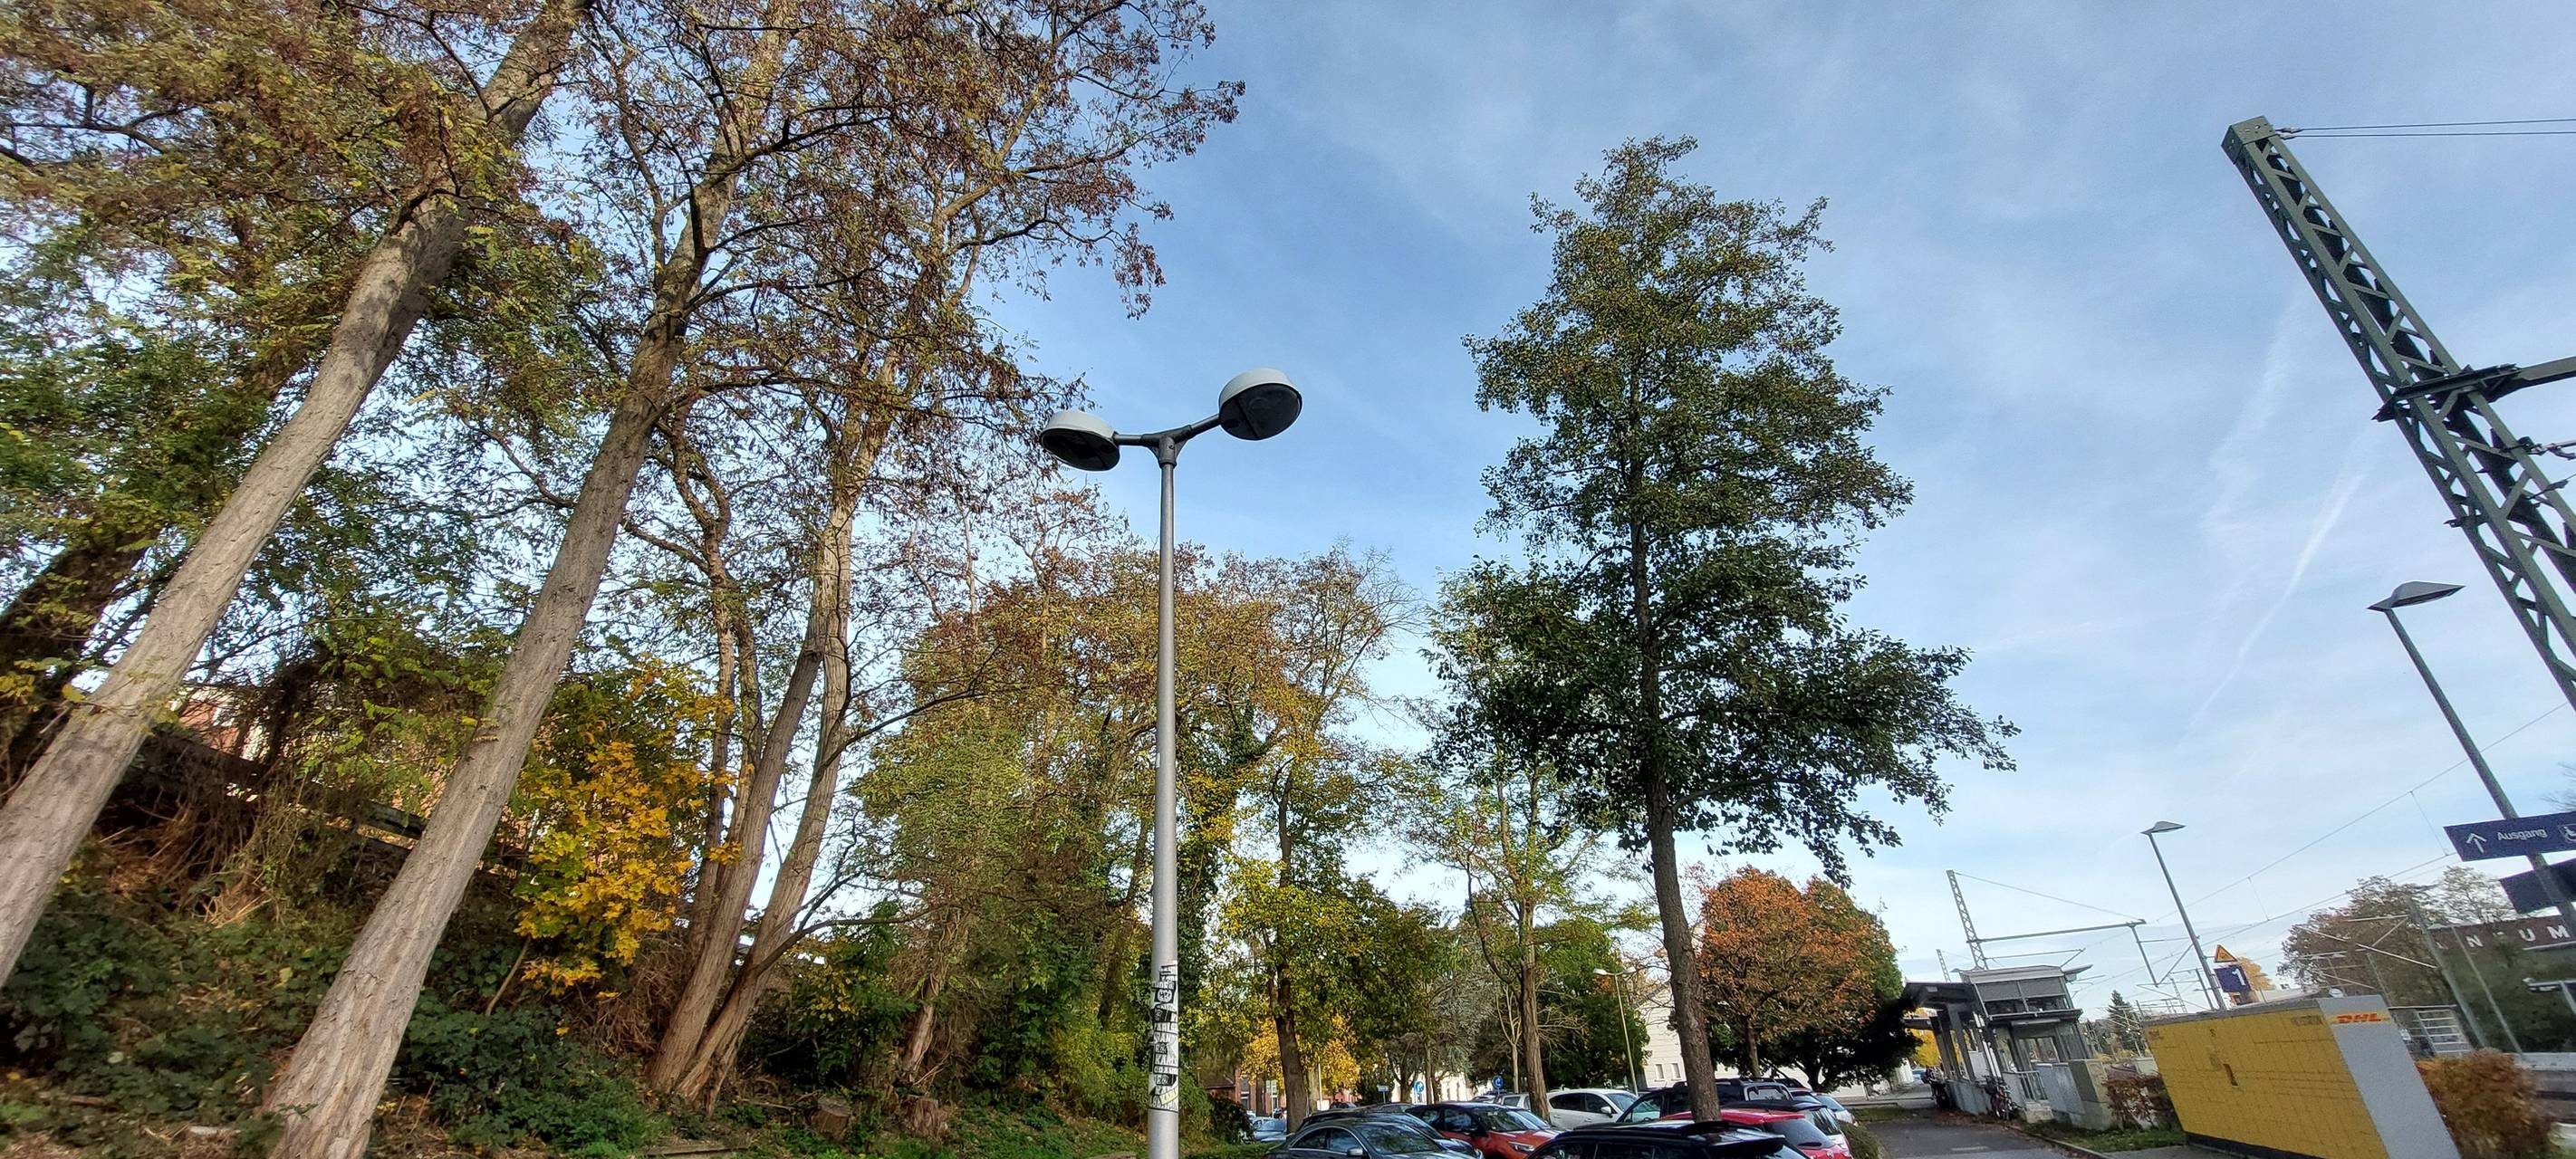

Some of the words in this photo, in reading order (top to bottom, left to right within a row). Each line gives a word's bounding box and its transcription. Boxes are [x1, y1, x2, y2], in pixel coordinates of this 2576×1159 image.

[2497, 829, 2548, 841] Ausgang
[2231, 968, 2246, 986] 1
[2336, 1012, 2382, 1024] DHL
